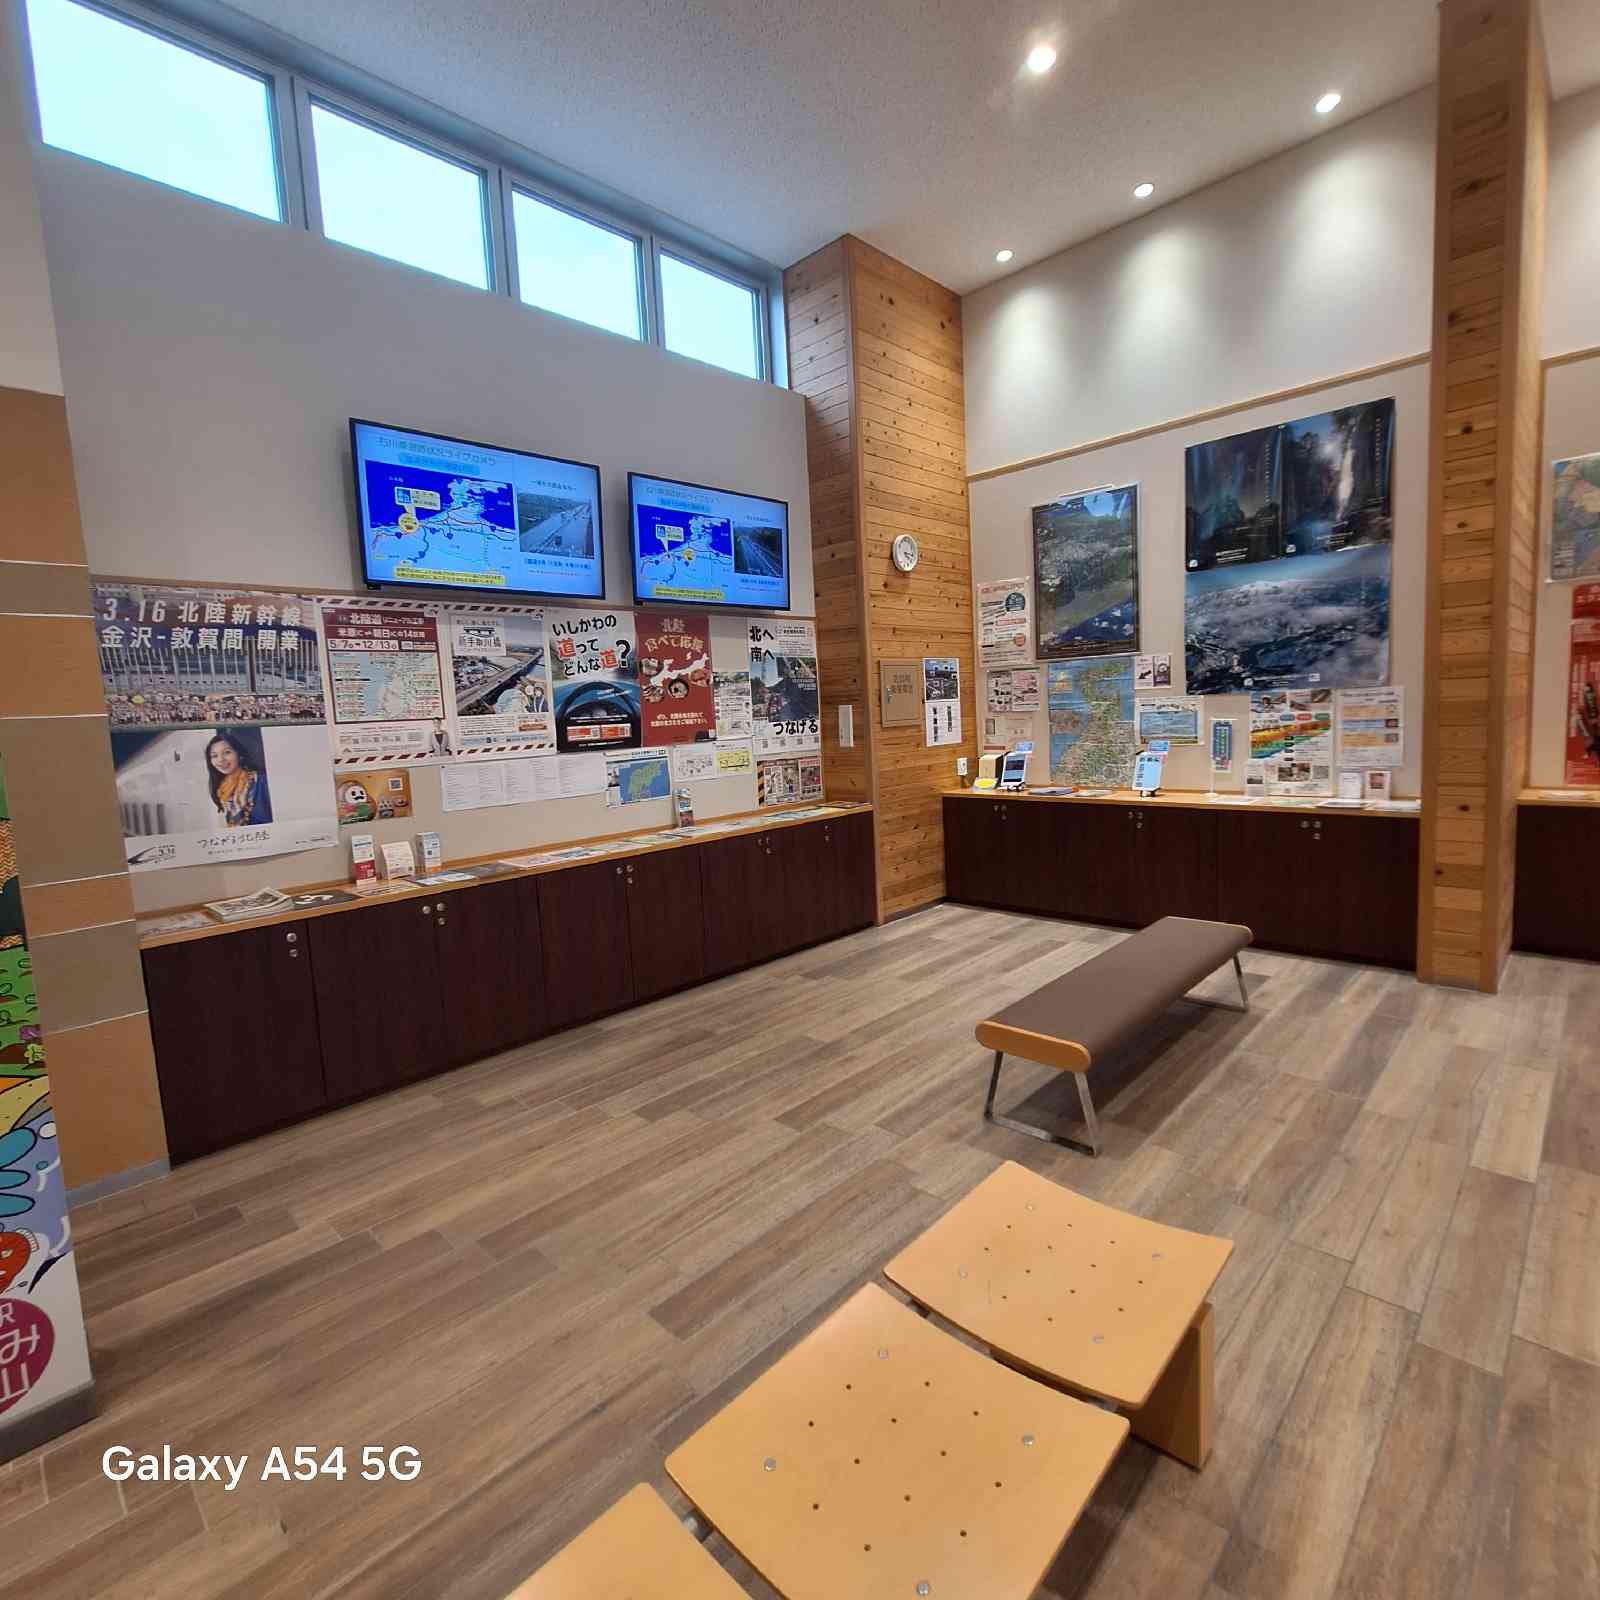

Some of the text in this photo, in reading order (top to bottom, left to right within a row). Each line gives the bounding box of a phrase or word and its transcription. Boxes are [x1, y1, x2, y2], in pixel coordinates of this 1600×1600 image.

[178, 601, 301, 627] 北陸新幹線
[552, 615, 617, 636] いしかわの
[749, 625, 774, 642] 北へ
[256, 629, 300, 651] 開業
[557, 637, 600, 657] 道って
[564, 640, 631, 676] どんな道?
[750, 646, 775, 663] 南へ
[773, 719, 818, 736] つなげる
